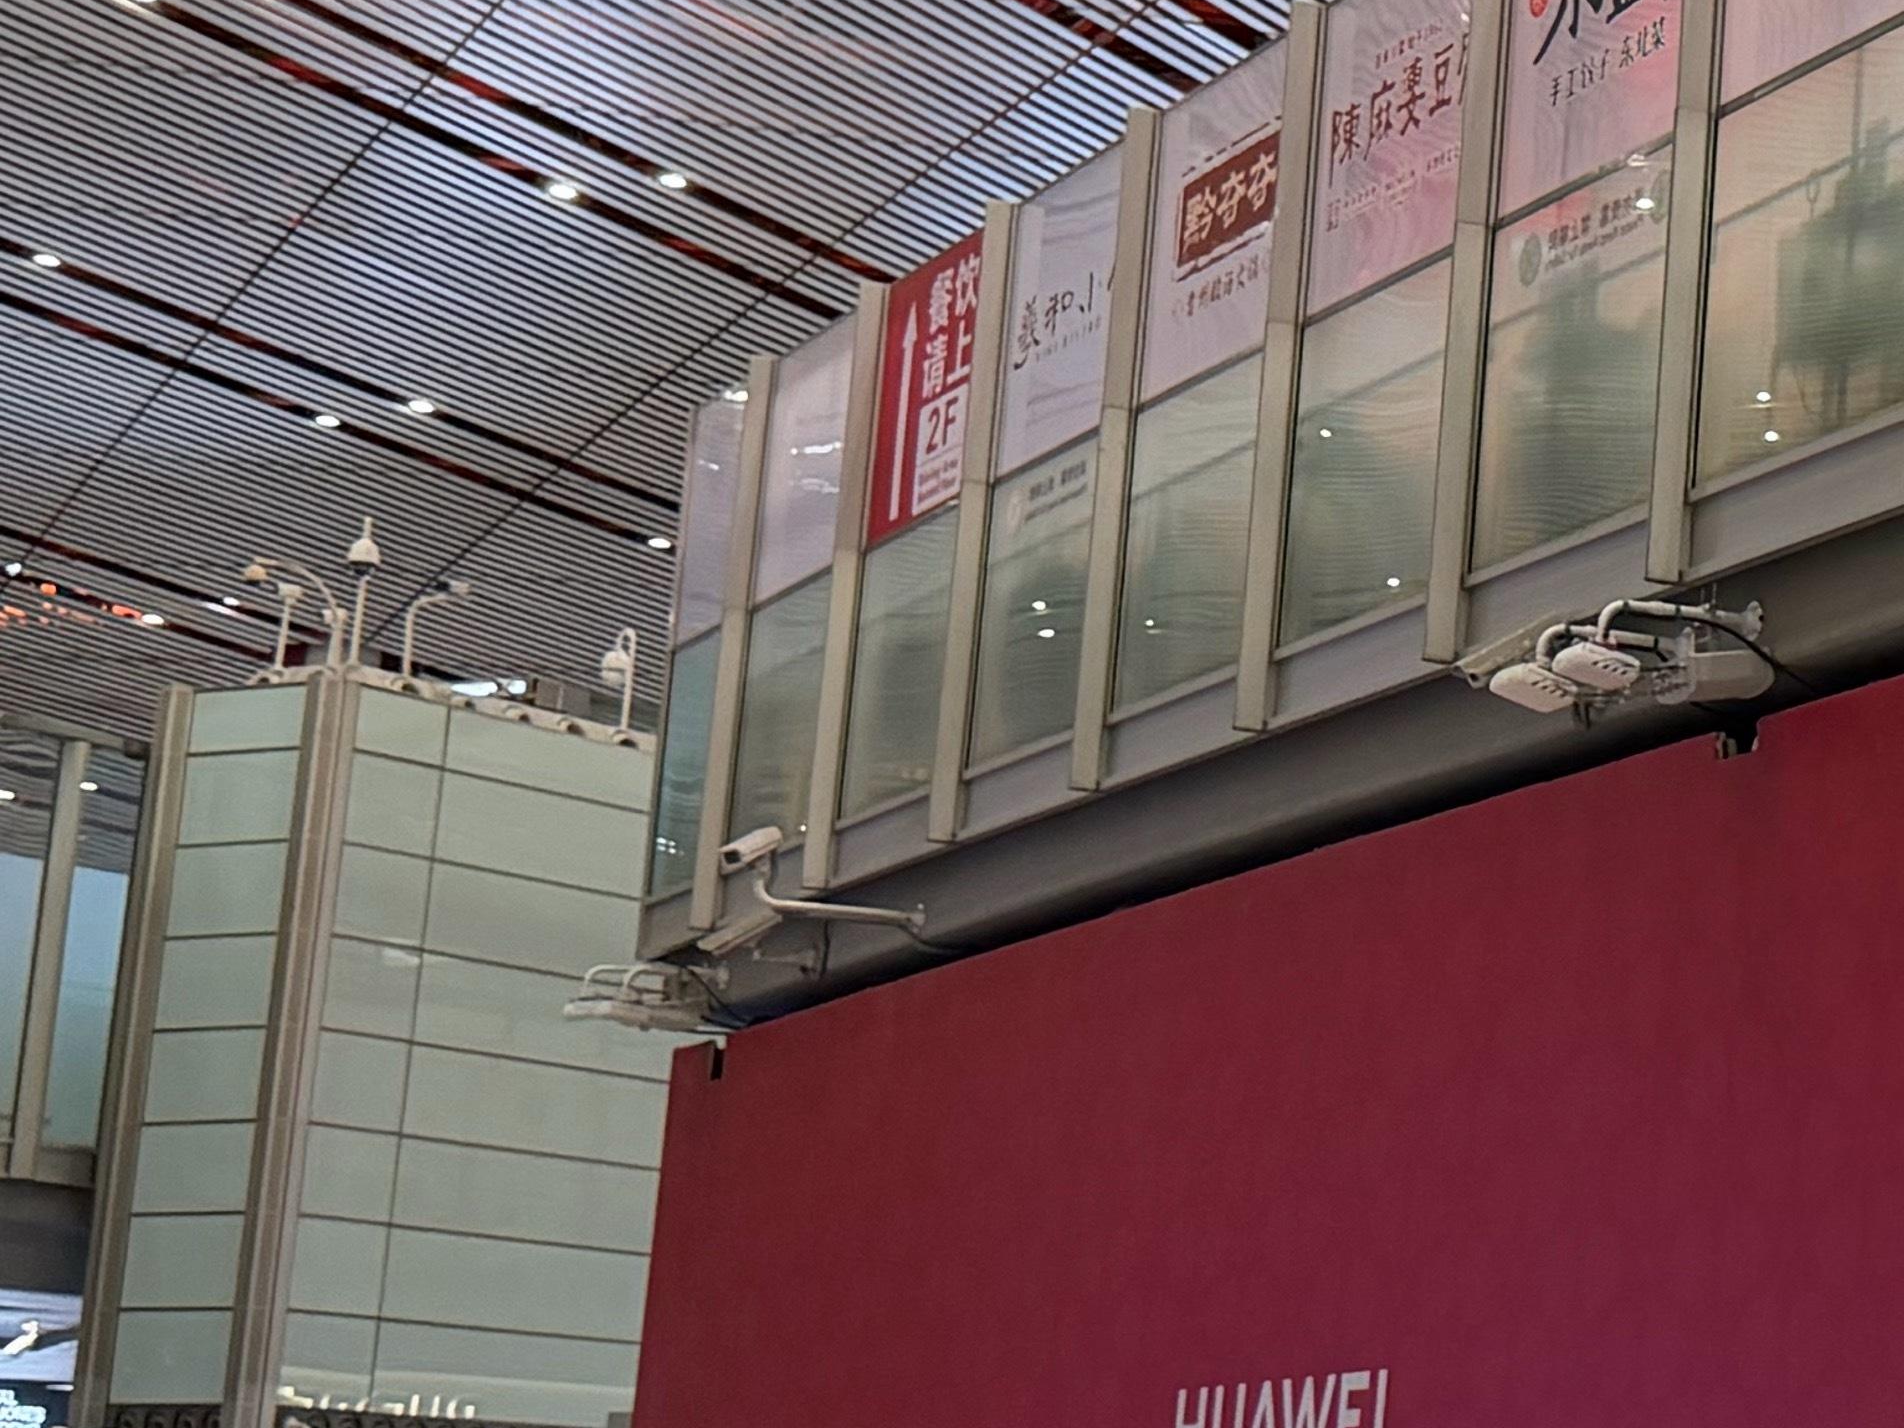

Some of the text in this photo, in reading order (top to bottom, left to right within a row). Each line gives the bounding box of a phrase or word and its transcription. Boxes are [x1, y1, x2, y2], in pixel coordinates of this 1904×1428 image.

[1329, 31, 1470, 189] 陳麻婆豆
[928, 253, 981, 335] 餐饮
[922, 320, 971, 398] 请上
[926, 396, 959, 454] 2F
